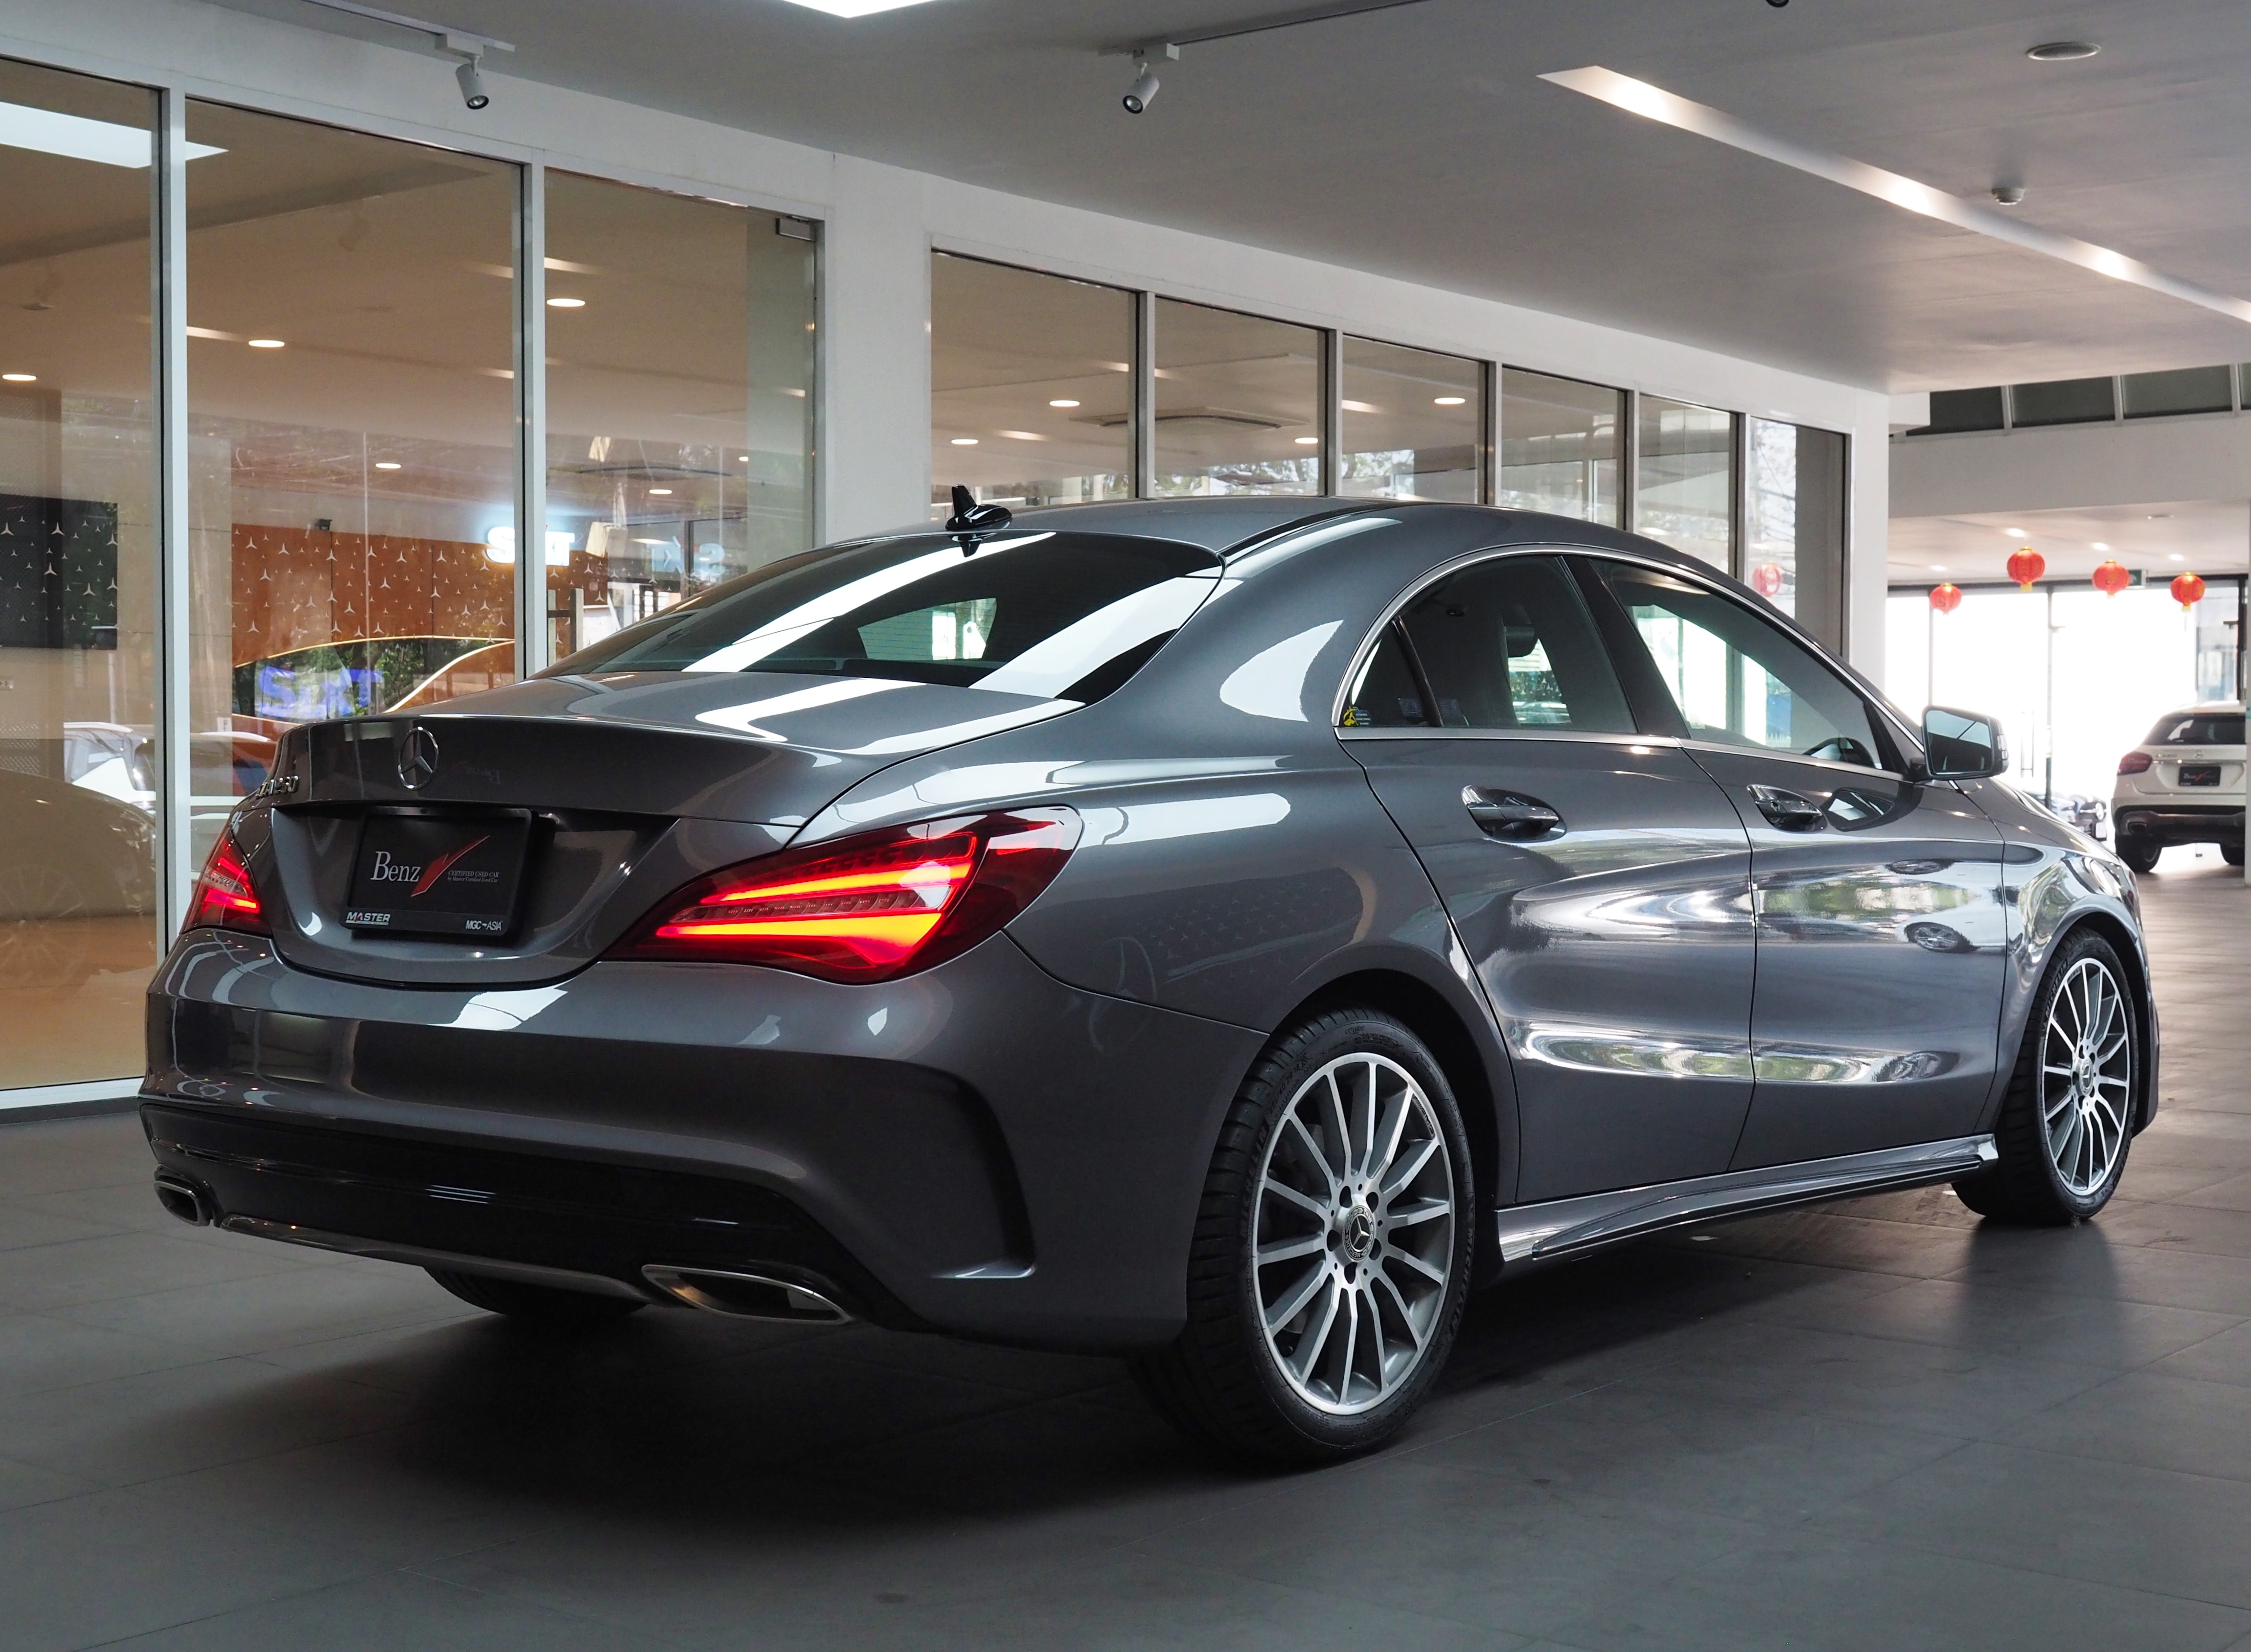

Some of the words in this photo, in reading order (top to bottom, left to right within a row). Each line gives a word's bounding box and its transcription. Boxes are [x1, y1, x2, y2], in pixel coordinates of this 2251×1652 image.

[370, 851, 421, 883] Benz
[347, 912, 391, 922] MASTER
[1451, 1227, 1473, 1329] MICHELIN
